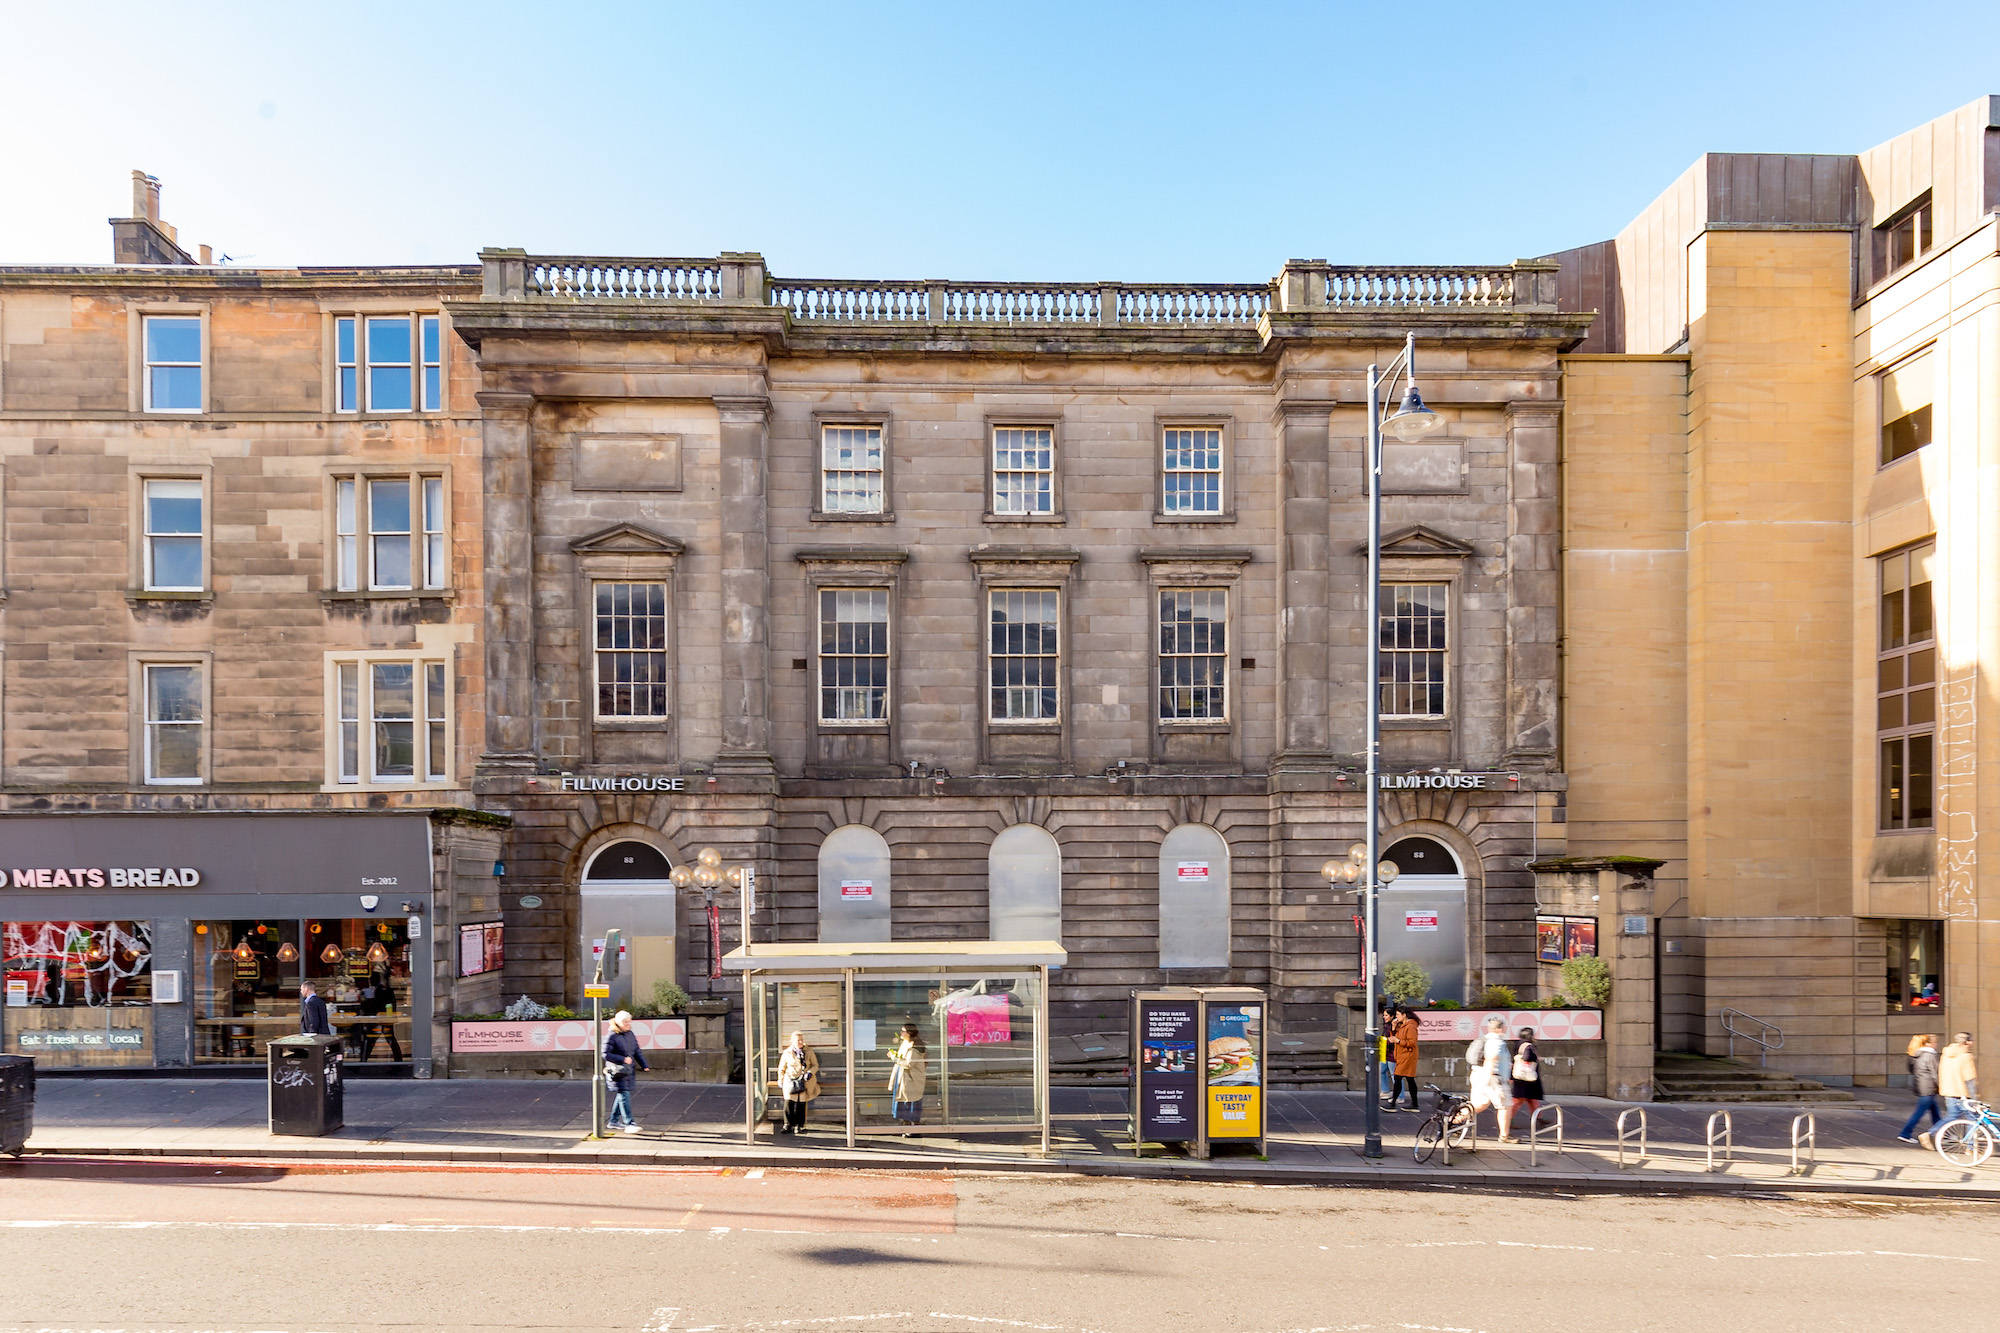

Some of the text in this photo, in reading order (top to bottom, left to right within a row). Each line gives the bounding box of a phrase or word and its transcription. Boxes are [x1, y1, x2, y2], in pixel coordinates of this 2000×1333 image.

[561, 777, 684, 790] FILMHOUSE
[1379, 775, 1486, 788] ILMHOUSE
[12, 868, 105, 888] MEATS
[109, 867, 200, 888] BREAD
[20, 1035, 41, 1045] Eat
[109, 1033, 142, 1044] local
[987, 1031, 1010, 1042] YOU
[1222, 1111, 1247, 1120] VALUE
